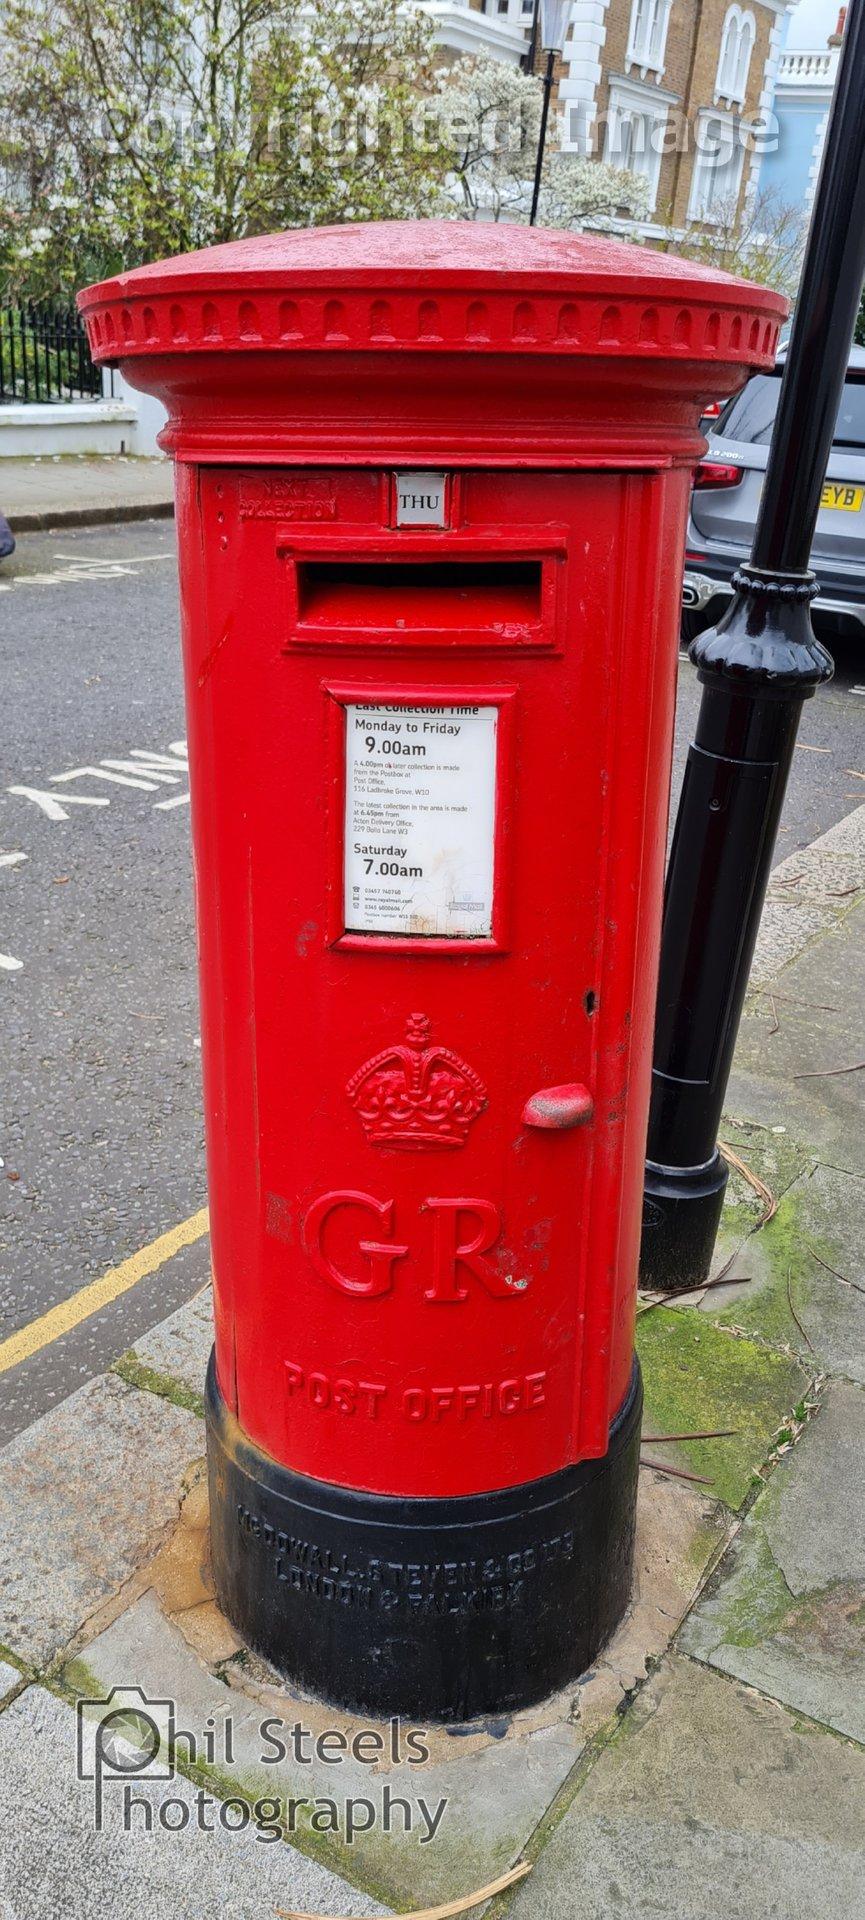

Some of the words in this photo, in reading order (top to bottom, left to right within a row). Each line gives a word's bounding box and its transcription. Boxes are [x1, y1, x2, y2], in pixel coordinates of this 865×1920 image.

[400, 494, 440, 511] THU
[355, 719, 401, 734] Monday
[406, 723, 418, 732] to
[423, 722, 461, 736] Friday
[365, 736, 426, 756] 9.00am
[360, 760, 384, 769] 4.00pm
[407, 763, 435, 771] collection
[381, 770, 403, 778] Postbox
[367, 786, 394, 795] Ladbroke
[360, 809, 384, 817] 6.45pm
[366, 801, 382, 809] latest
[383, 802, 410, 810] collection
[371, 818, 394, 827] Delivery
[382, 827, 396, 835] Lane
[353, 843, 408, 859] Saturday
[363, 859, 423, 877] 7.00am
[303, 1189, 529, 1302] GR
[284, 1360, 388, 1419] POST
[403, 1371, 546, 1423] OFFICE
[368, 1558, 477, 1586] STEVEN
[483, 1557, 502, 1580] &
[274, 1557, 372, 1611] LONDON
